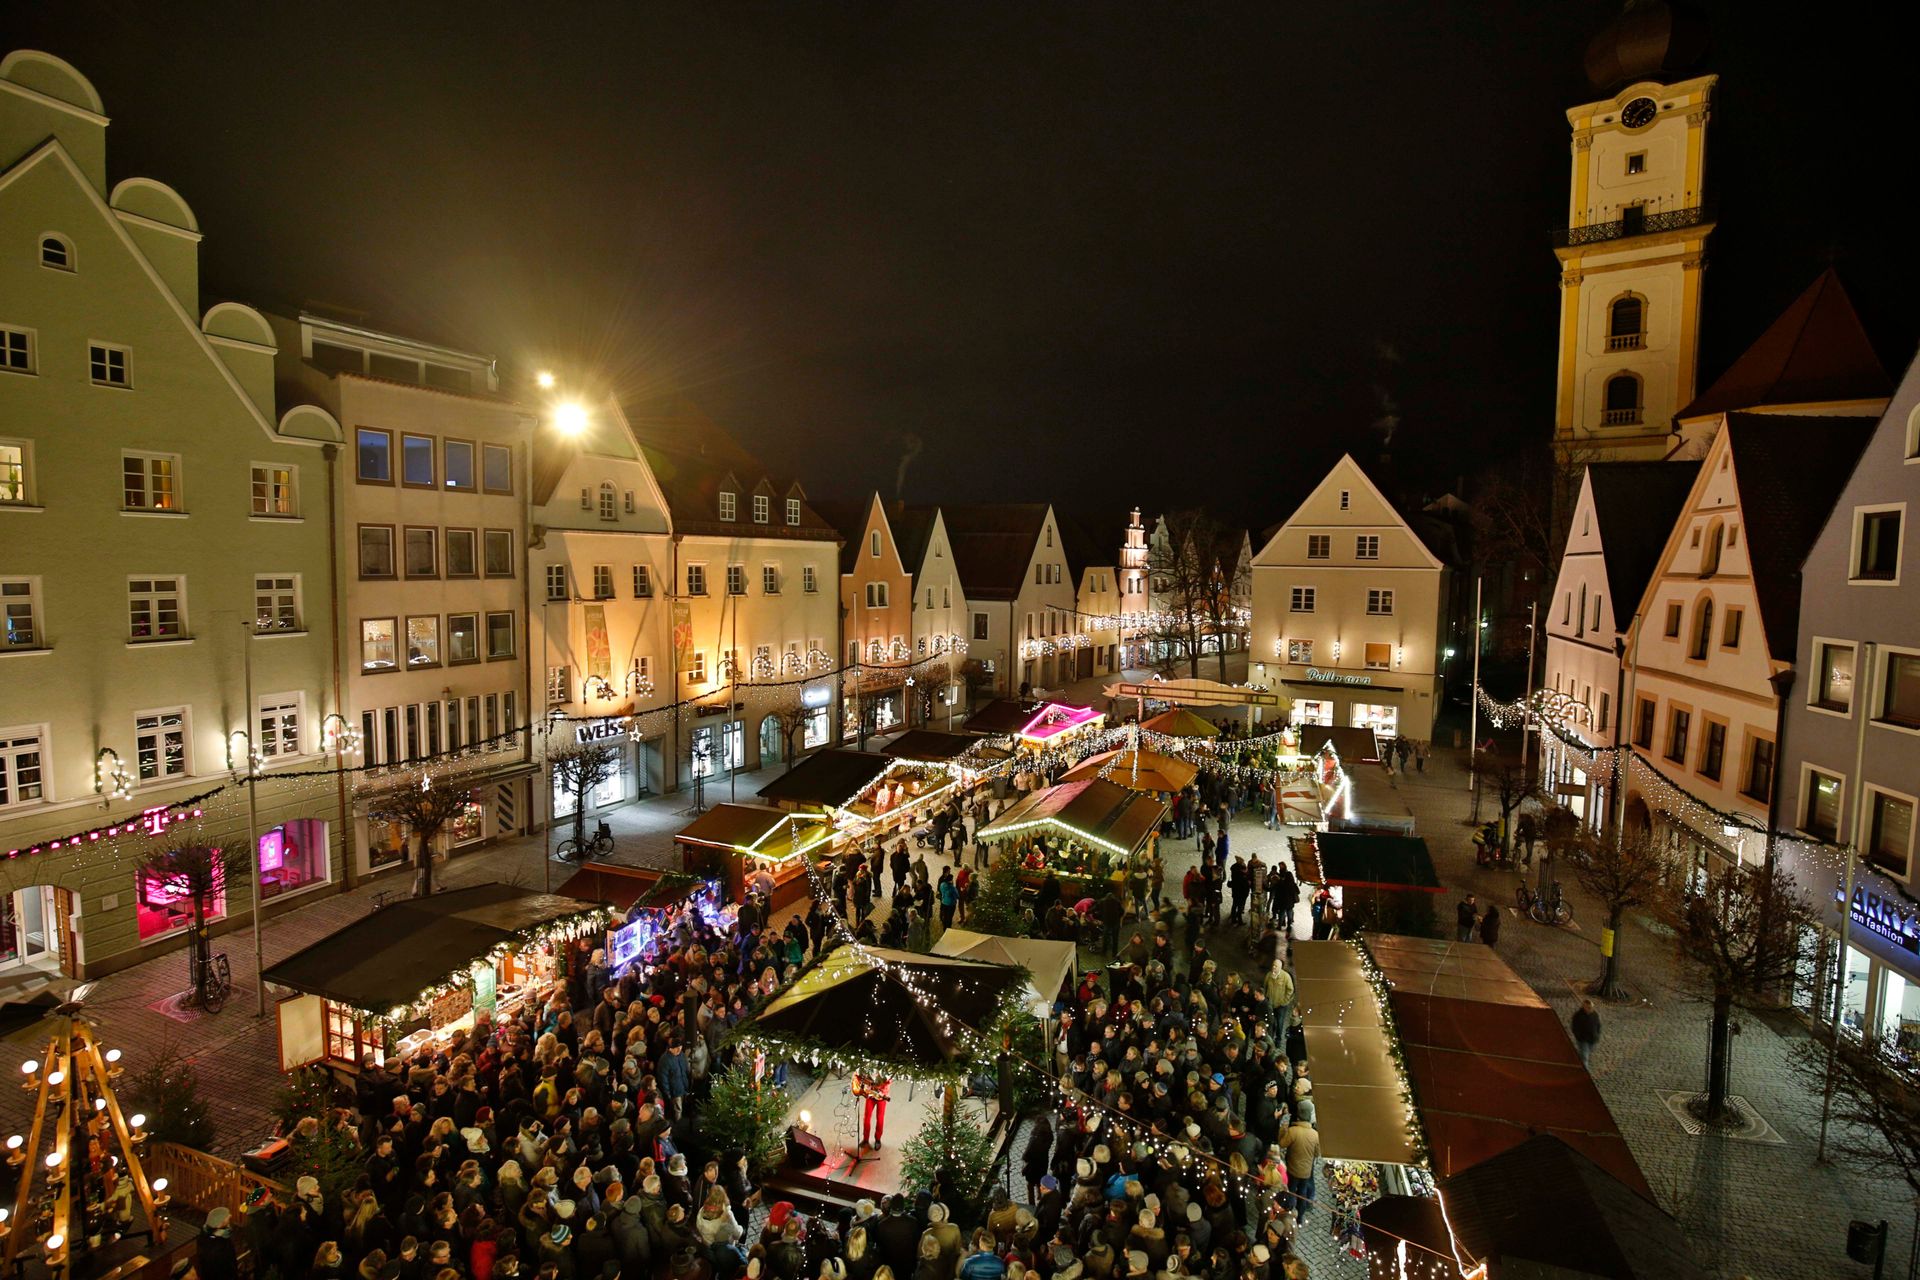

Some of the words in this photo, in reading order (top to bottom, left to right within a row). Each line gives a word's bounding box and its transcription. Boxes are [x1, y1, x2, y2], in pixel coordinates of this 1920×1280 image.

[1305, 667, 1371, 686] Pollmann
[143, 805, 169, 836] T
[1866, 917, 1905, 945] fashion
